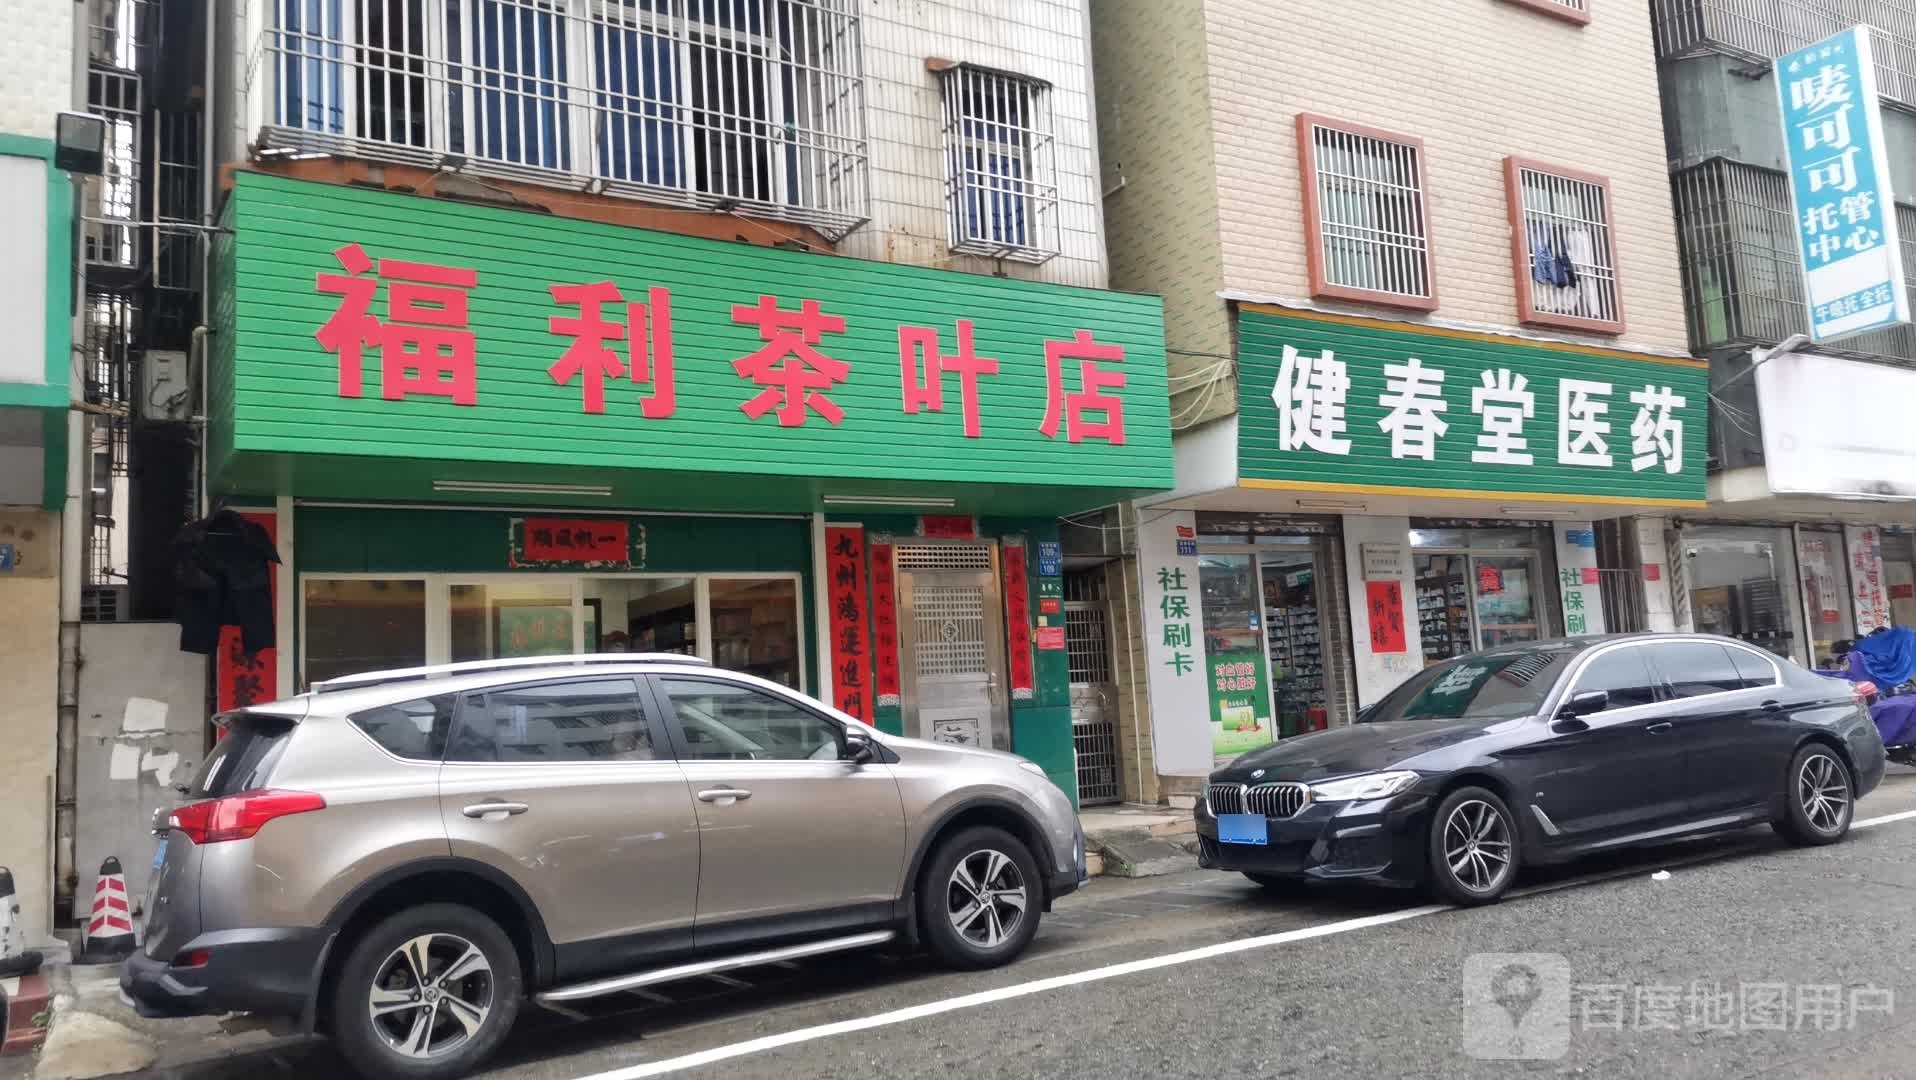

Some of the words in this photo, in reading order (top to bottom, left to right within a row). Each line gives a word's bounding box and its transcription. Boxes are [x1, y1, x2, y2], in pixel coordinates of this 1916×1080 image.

[1803, 191, 1875, 234] 托管
[1808, 226, 1881, 262] 中心
[315, 242, 1126, 446] 福利茶叶店
[1271, 344, 1687, 475] 健春堂医药
[1157, 566, 1195, 678] 社保刷卡
[1560, 567, 1586, 634] 社保刷
